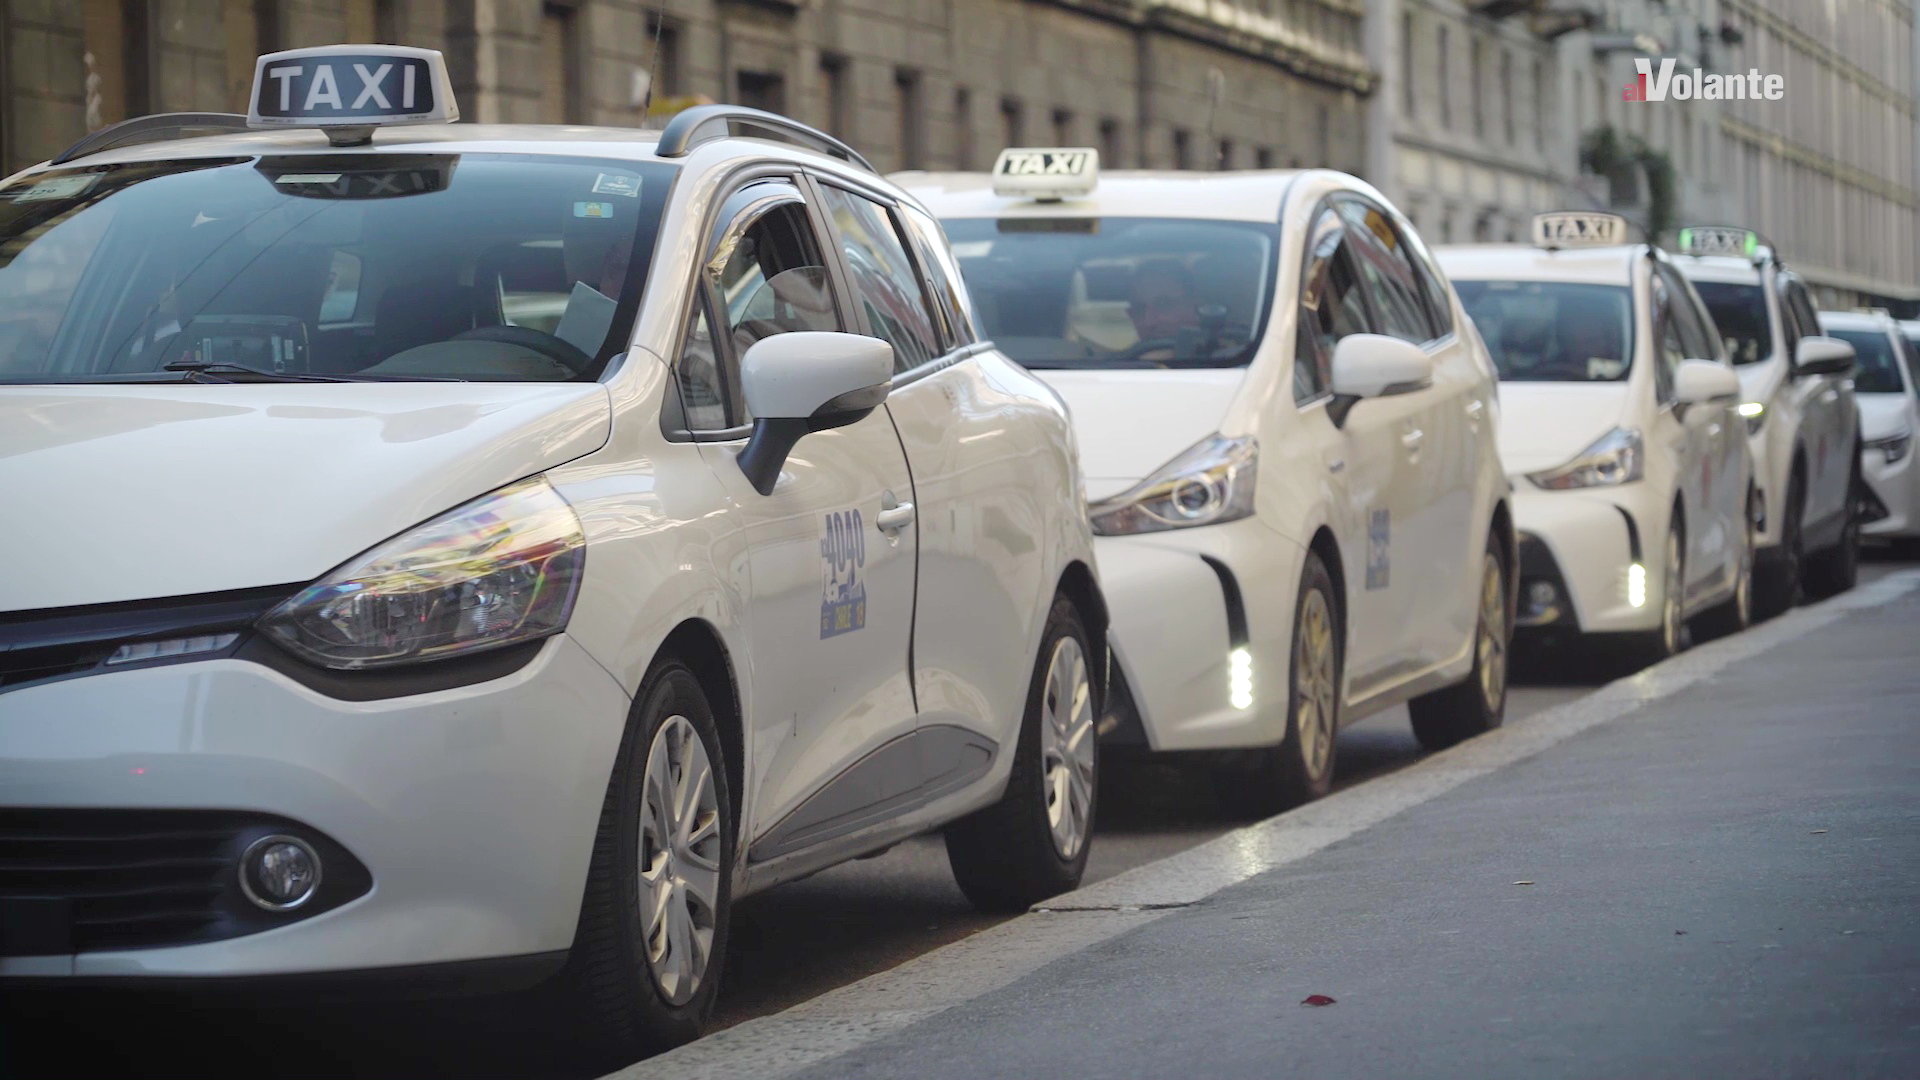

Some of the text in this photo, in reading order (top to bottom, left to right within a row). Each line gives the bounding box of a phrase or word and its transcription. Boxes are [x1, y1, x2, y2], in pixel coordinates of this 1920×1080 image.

[269, 63, 416, 111] TAXI
[1006, 153, 1084, 174] TAXI
[1545, 220, 1614, 240] TAXI
[1693, 231, 1744, 250] TAXI
